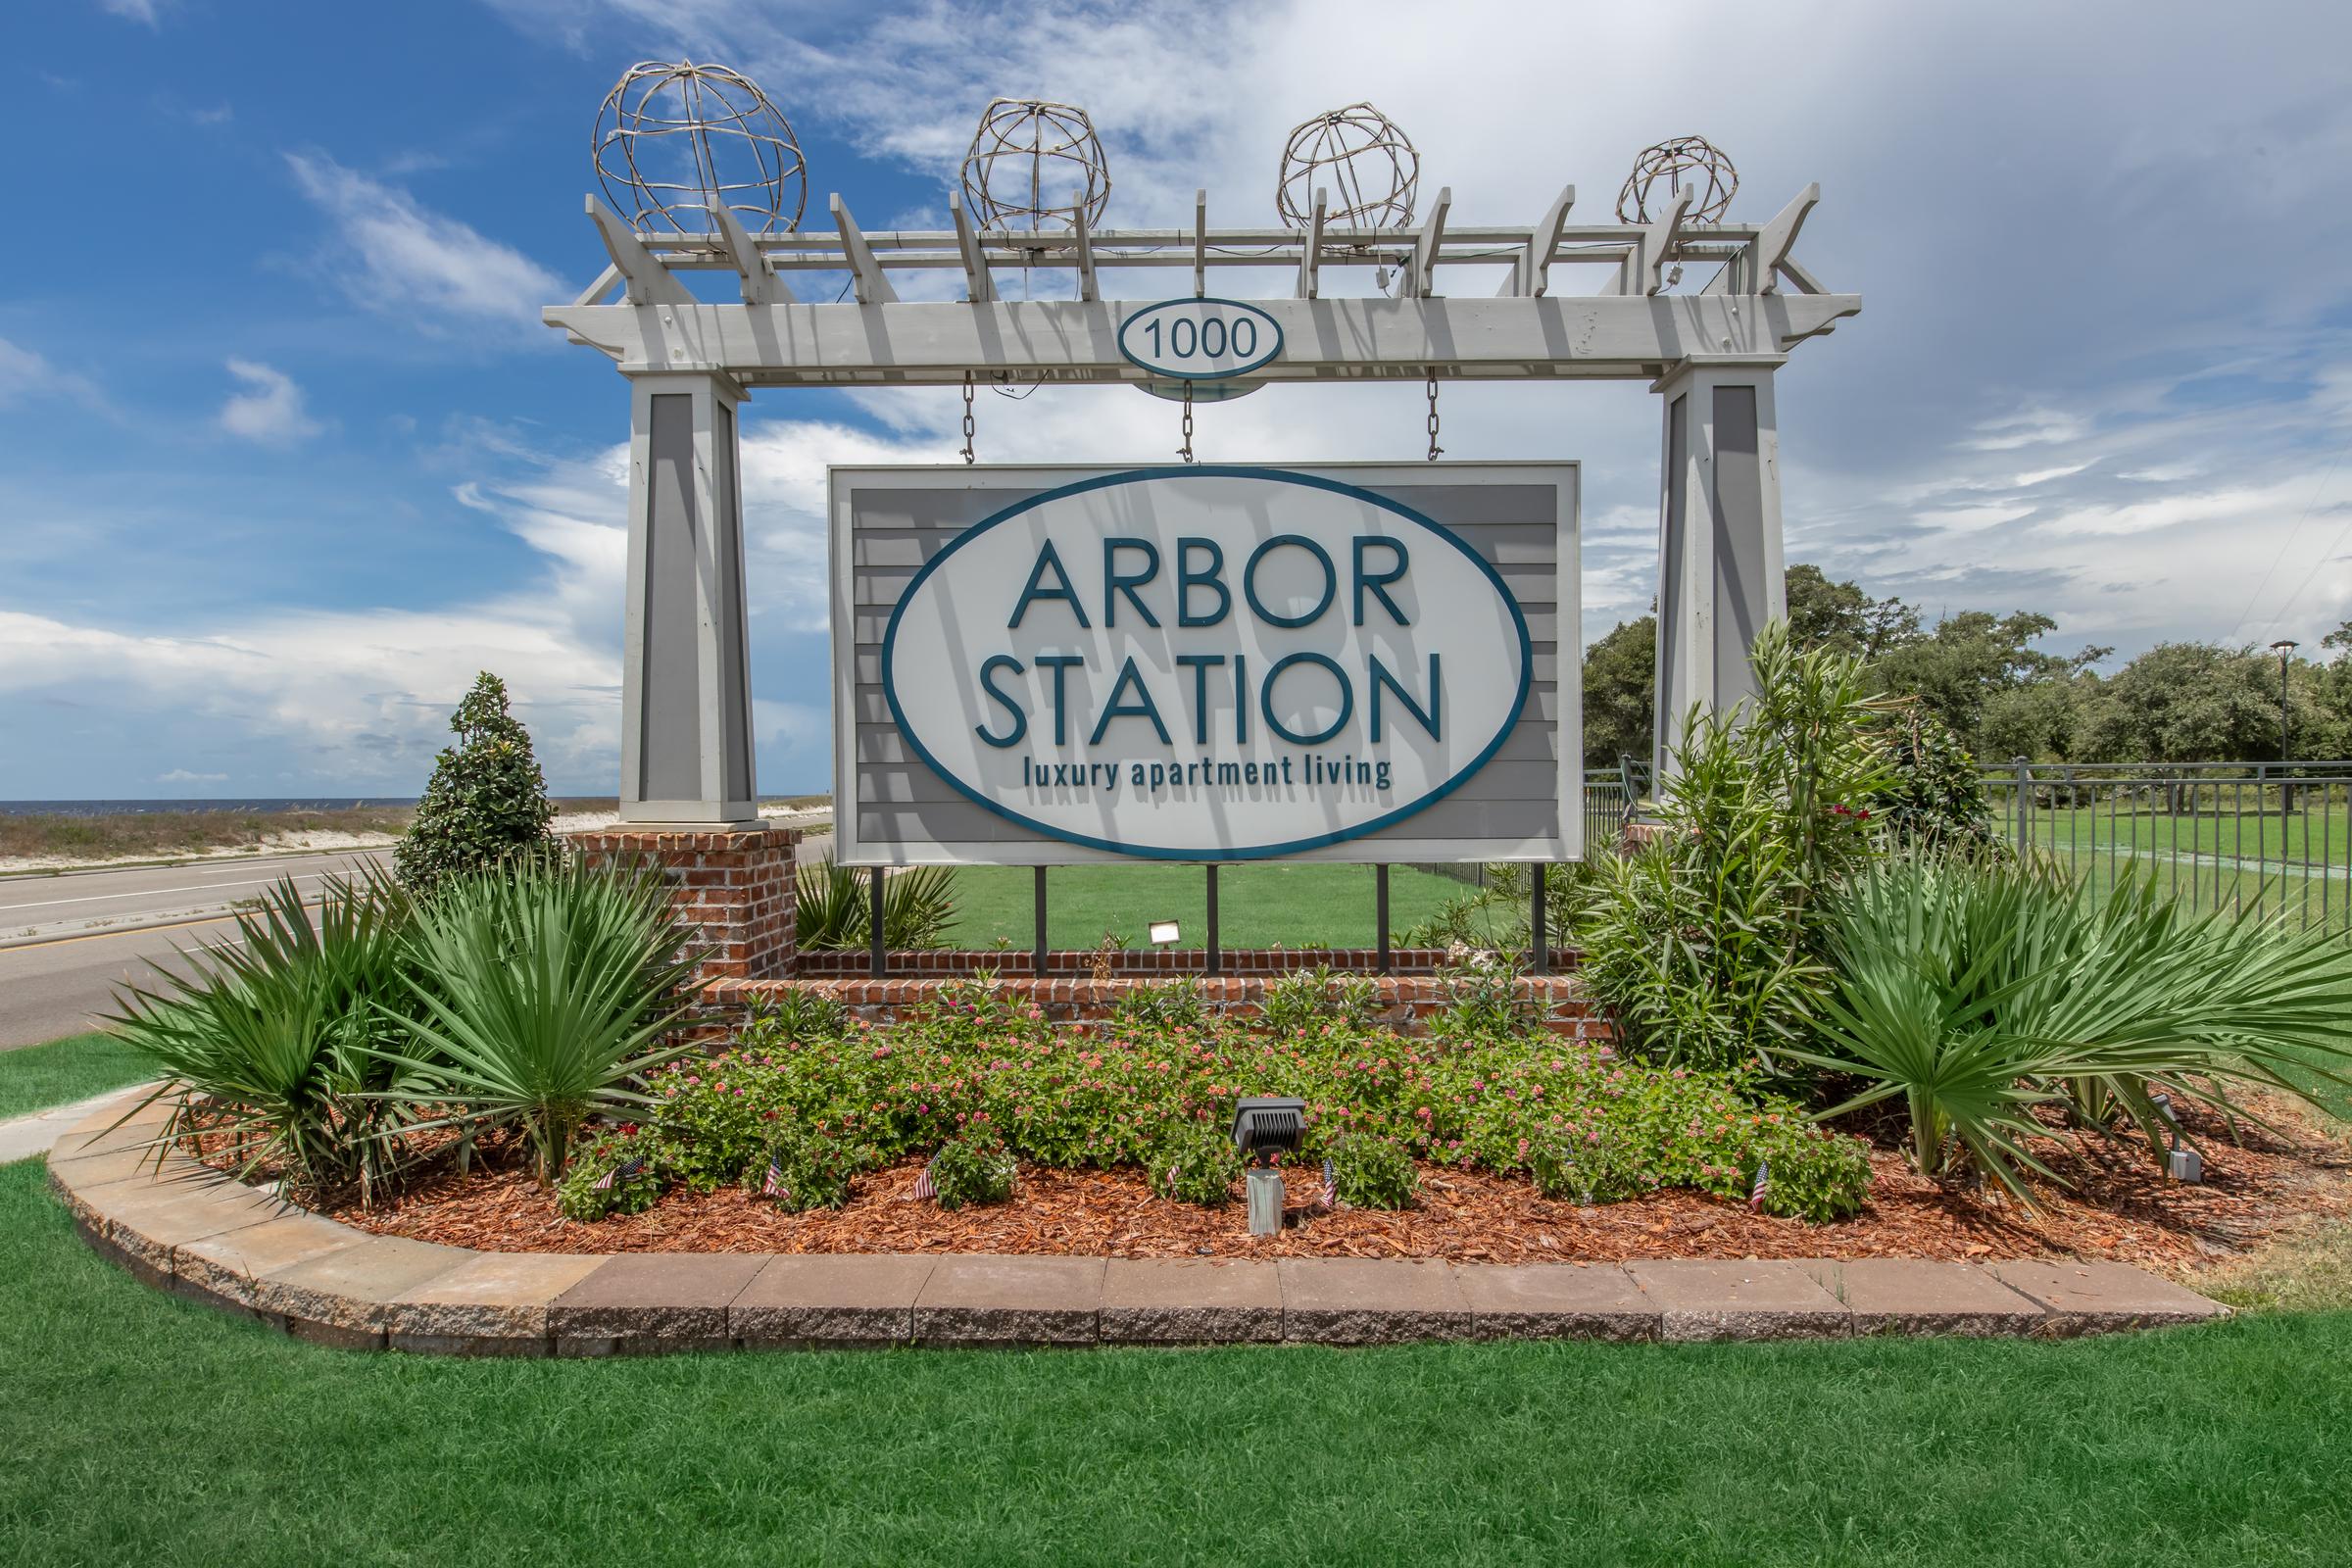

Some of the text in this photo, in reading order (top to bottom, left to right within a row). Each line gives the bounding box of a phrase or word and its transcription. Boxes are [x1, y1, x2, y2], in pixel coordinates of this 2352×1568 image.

[1145, 317, 1257, 359] 1000
[1006, 534, 1411, 629] ARBOR
[974, 652, 1442, 750] STATION
[1023, 754, 1392, 793] luxury apartment living
